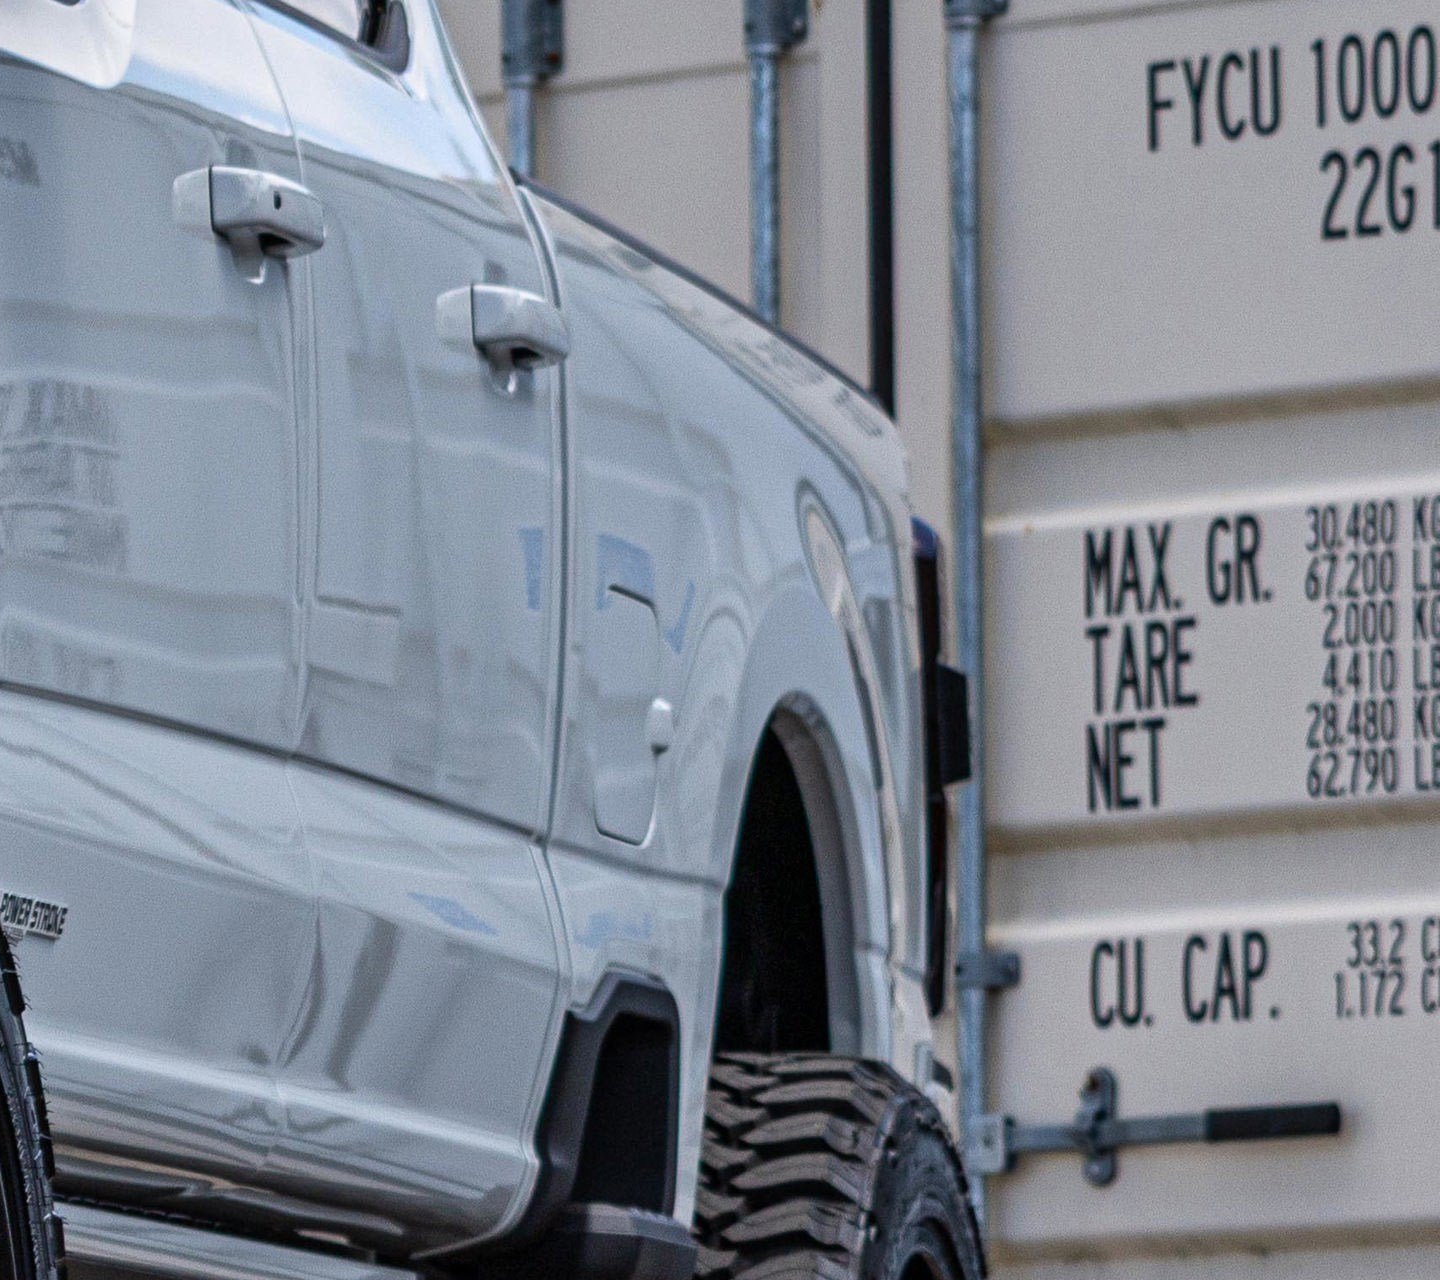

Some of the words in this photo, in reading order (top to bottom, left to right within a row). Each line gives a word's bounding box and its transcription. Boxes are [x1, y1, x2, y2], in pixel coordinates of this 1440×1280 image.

[1145, 44, 1282, 152] FYCU
[1311, 24, 1436, 129] 1000
[1319, 139, 1440, 241] 22G1
[1083, 521, 1182, 619] MAX.
[1204, 514, 1273, 606] GR.
[1304, 497, 1398, 552] 30.480
[1304, 548, 1398, 602] 67.200
[1085, 619, 1198, 715] TARE
[1322, 598, 1398, 649] 2.000
[1322, 646, 1398, 697] 4.410
[1085, 718, 1167, 813] NET
[1305, 695, 1399, 750] 28.480
[1306, 745, 1399, 798] 62.790
[0, 892, 33, 927] POWER
[29, 901, 69, 936] STROKE
[1089, 939, 1153, 1029] CU.
[1182, 928, 1280, 1023] CAP.
